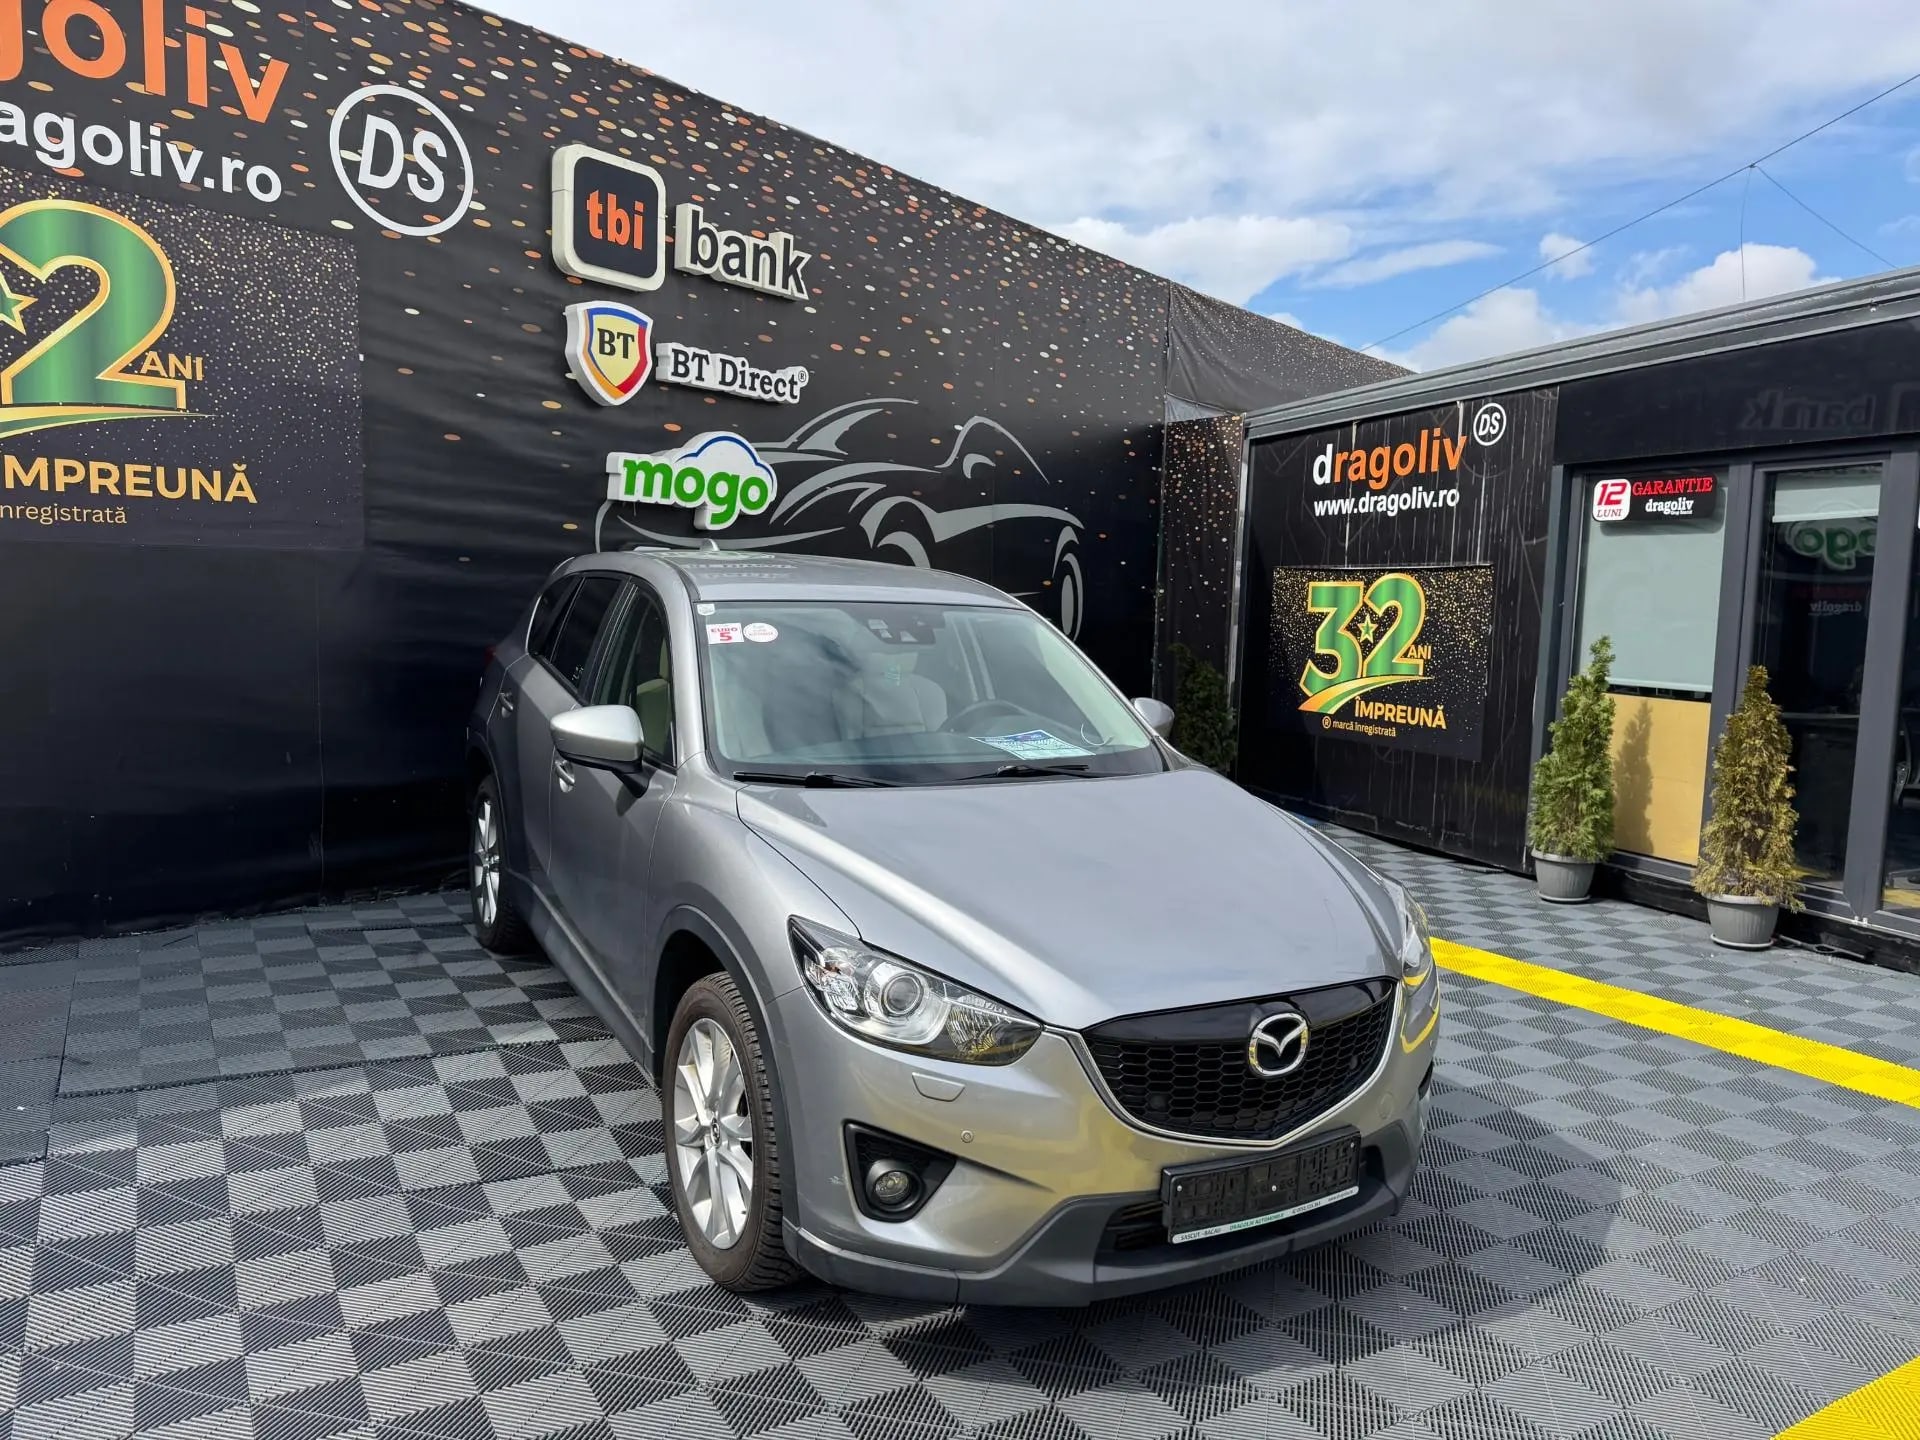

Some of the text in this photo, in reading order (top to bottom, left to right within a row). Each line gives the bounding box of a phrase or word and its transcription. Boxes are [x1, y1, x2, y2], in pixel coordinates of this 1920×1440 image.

[358, 114, 447, 203] DS
[587, 190, 644, 250] tbi
[690, 209, 808, 295] bank
[597, 328, 635, 360] BT
[140, 351, 204, 381] ANI
[671, 348, 710, 382] BT
[1478, 411, 1501, 436] DS
[1312, 427, 1467, 490] dragoliv
[623, 458, 769, 525] mogo
[1313, 486, 1460, 517] www.dragoliv.ro
[1597, 482, 1627, 506] 12
[1632, 477, 1713, 496] GARANTIE
[0, 503, 127, 525] nregistrată
[1597, 508, 1622, 518] LUNI
[1645, 497, 1694, 514] dragoliv
[719, 632, 732, 641] 5
[1300, 572, 1426, 697] 32
[1407, 645, 1432, 660] ANI
[1354, 696, 1447, 729] ÎMPREUNĂ
[1332, 720, 1354, 731] marcă
[1354, 721, 1397, 737] înregistrată
